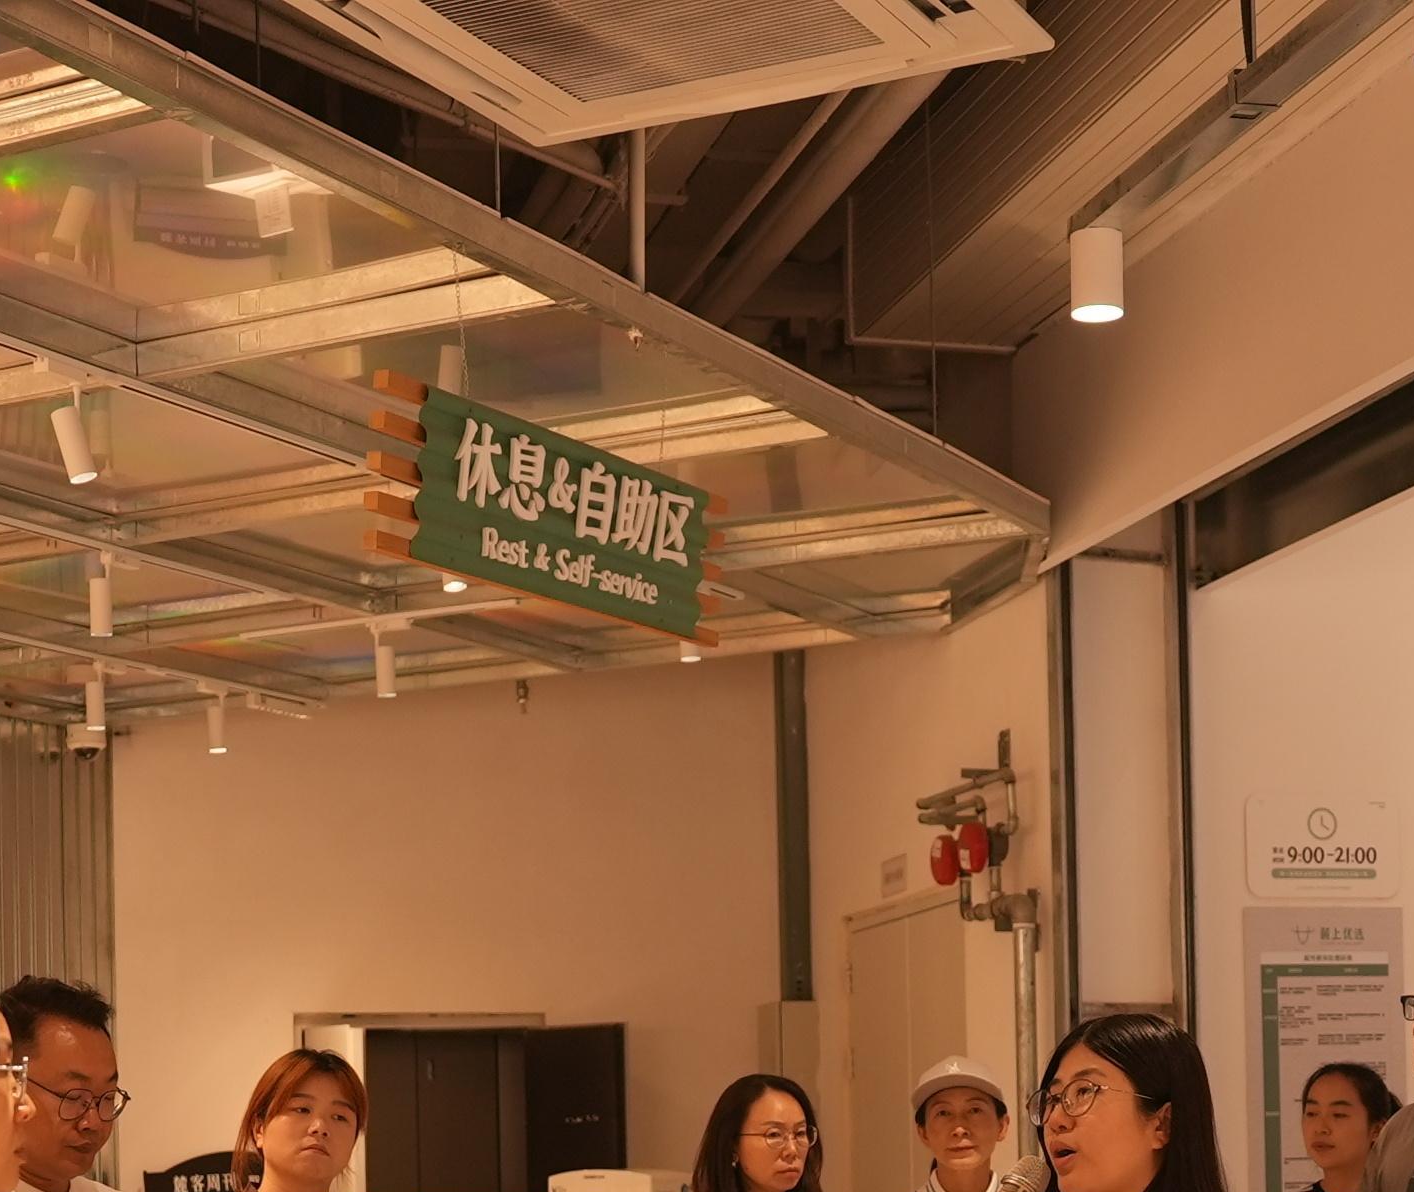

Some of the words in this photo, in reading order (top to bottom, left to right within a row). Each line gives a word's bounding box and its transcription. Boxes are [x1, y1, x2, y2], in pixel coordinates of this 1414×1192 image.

[454, 418, 694, 567] 休息&自助区
[481, 527, 529, 569] Rest
[534, 543, 551, 571] &
[553, 549, 659, 605] Self-service
